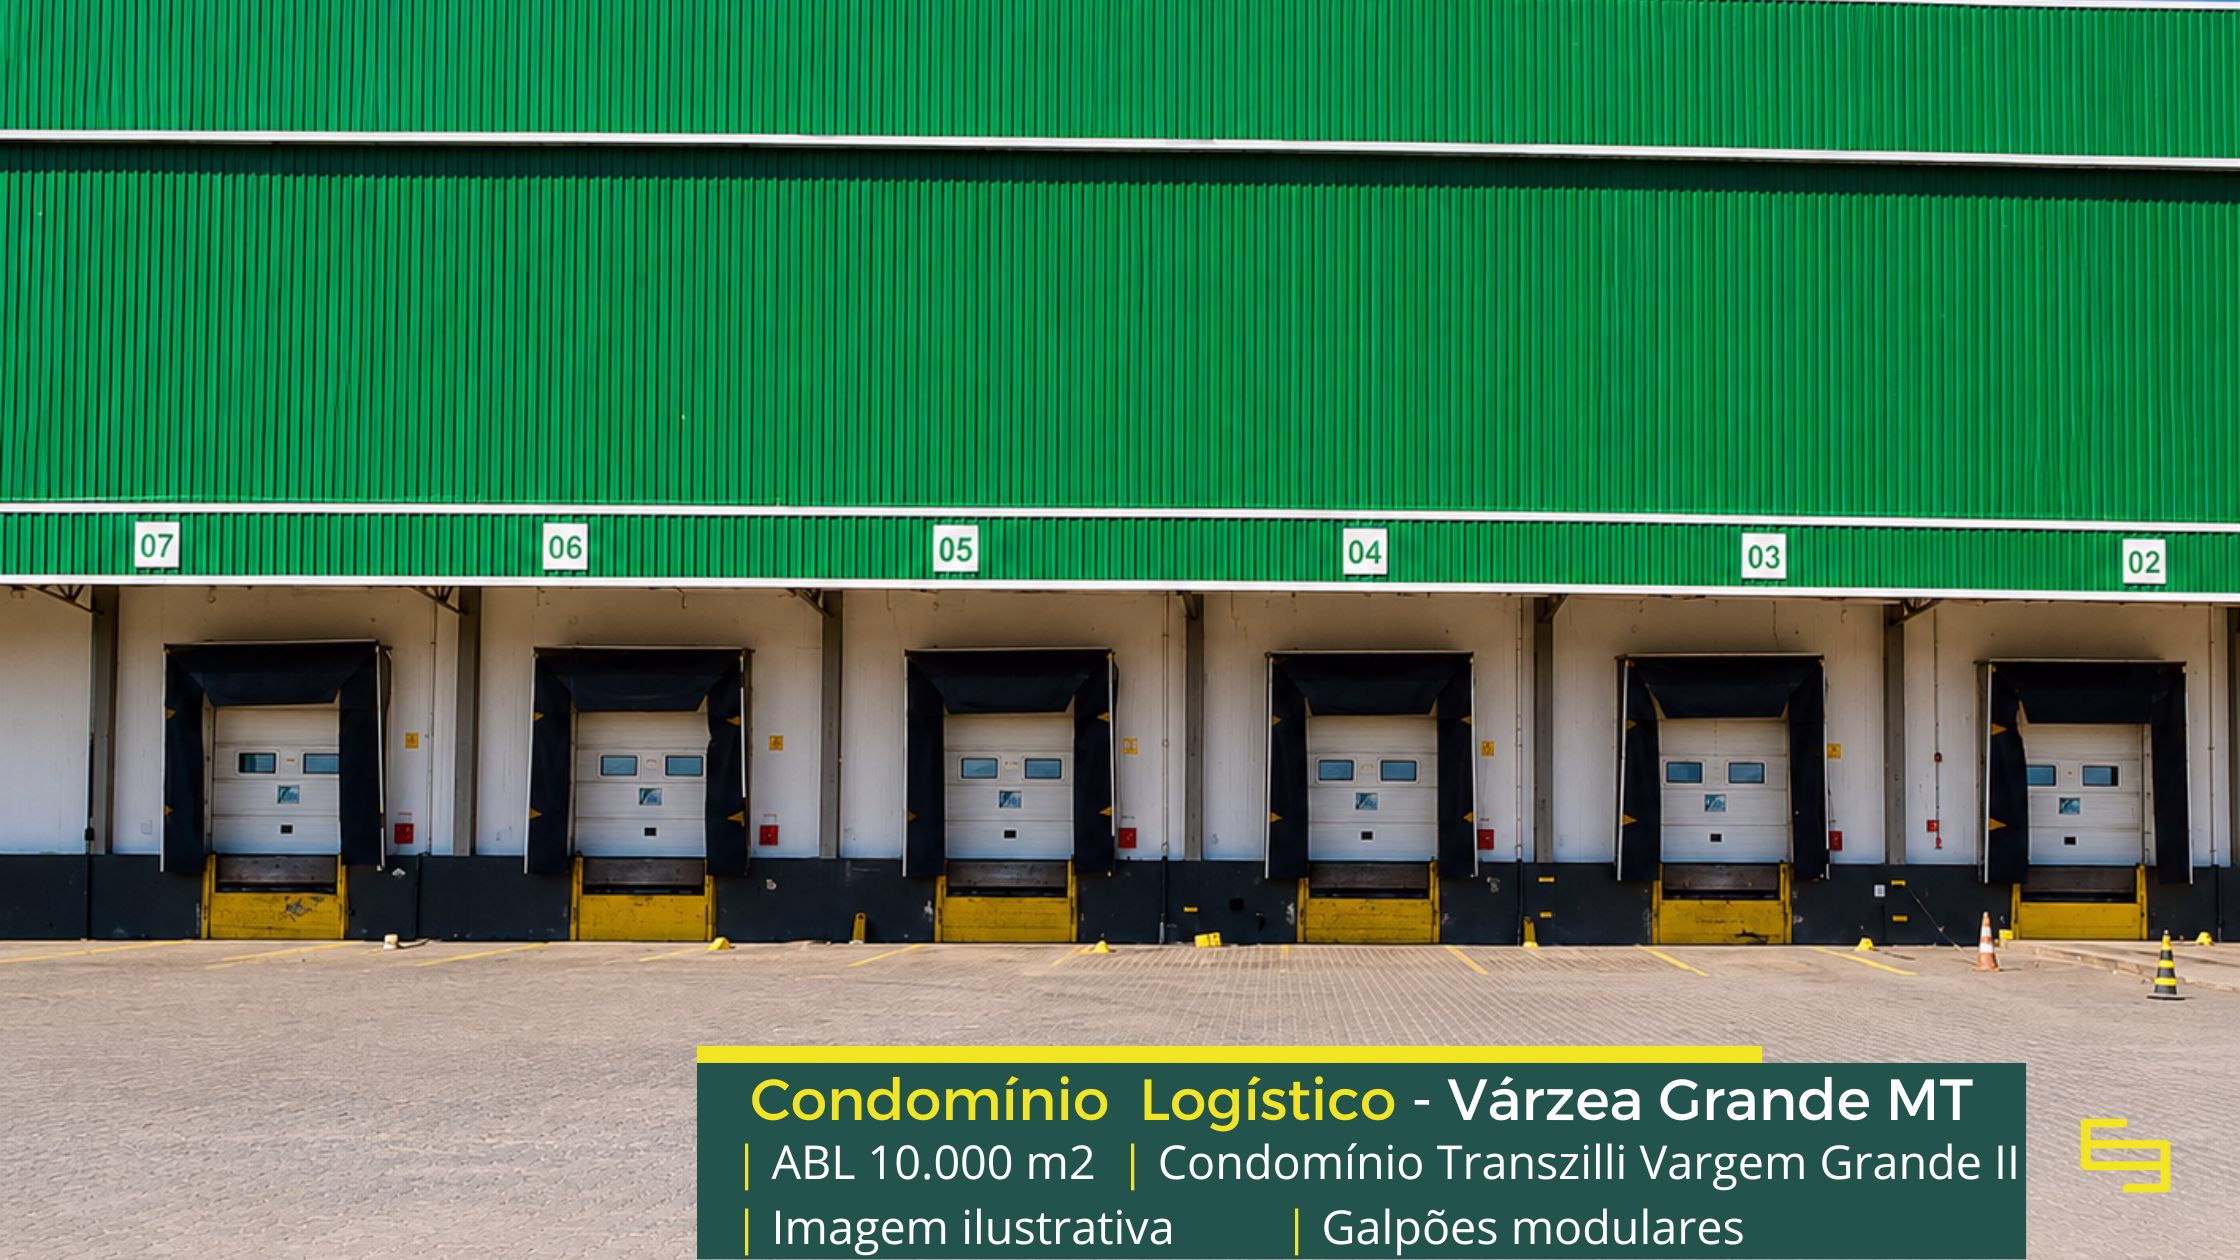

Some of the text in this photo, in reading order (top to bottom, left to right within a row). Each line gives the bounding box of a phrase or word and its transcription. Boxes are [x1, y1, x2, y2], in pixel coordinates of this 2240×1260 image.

[141, 534, 173, 558] 07
[549, 535, 582, 559] 06
[939, 538, 973, 562] 05
[1348, 540, 1382, 565] 04
[1748, 545, 1781, 569] 03
[2128, 551, 2160, 574] 02
